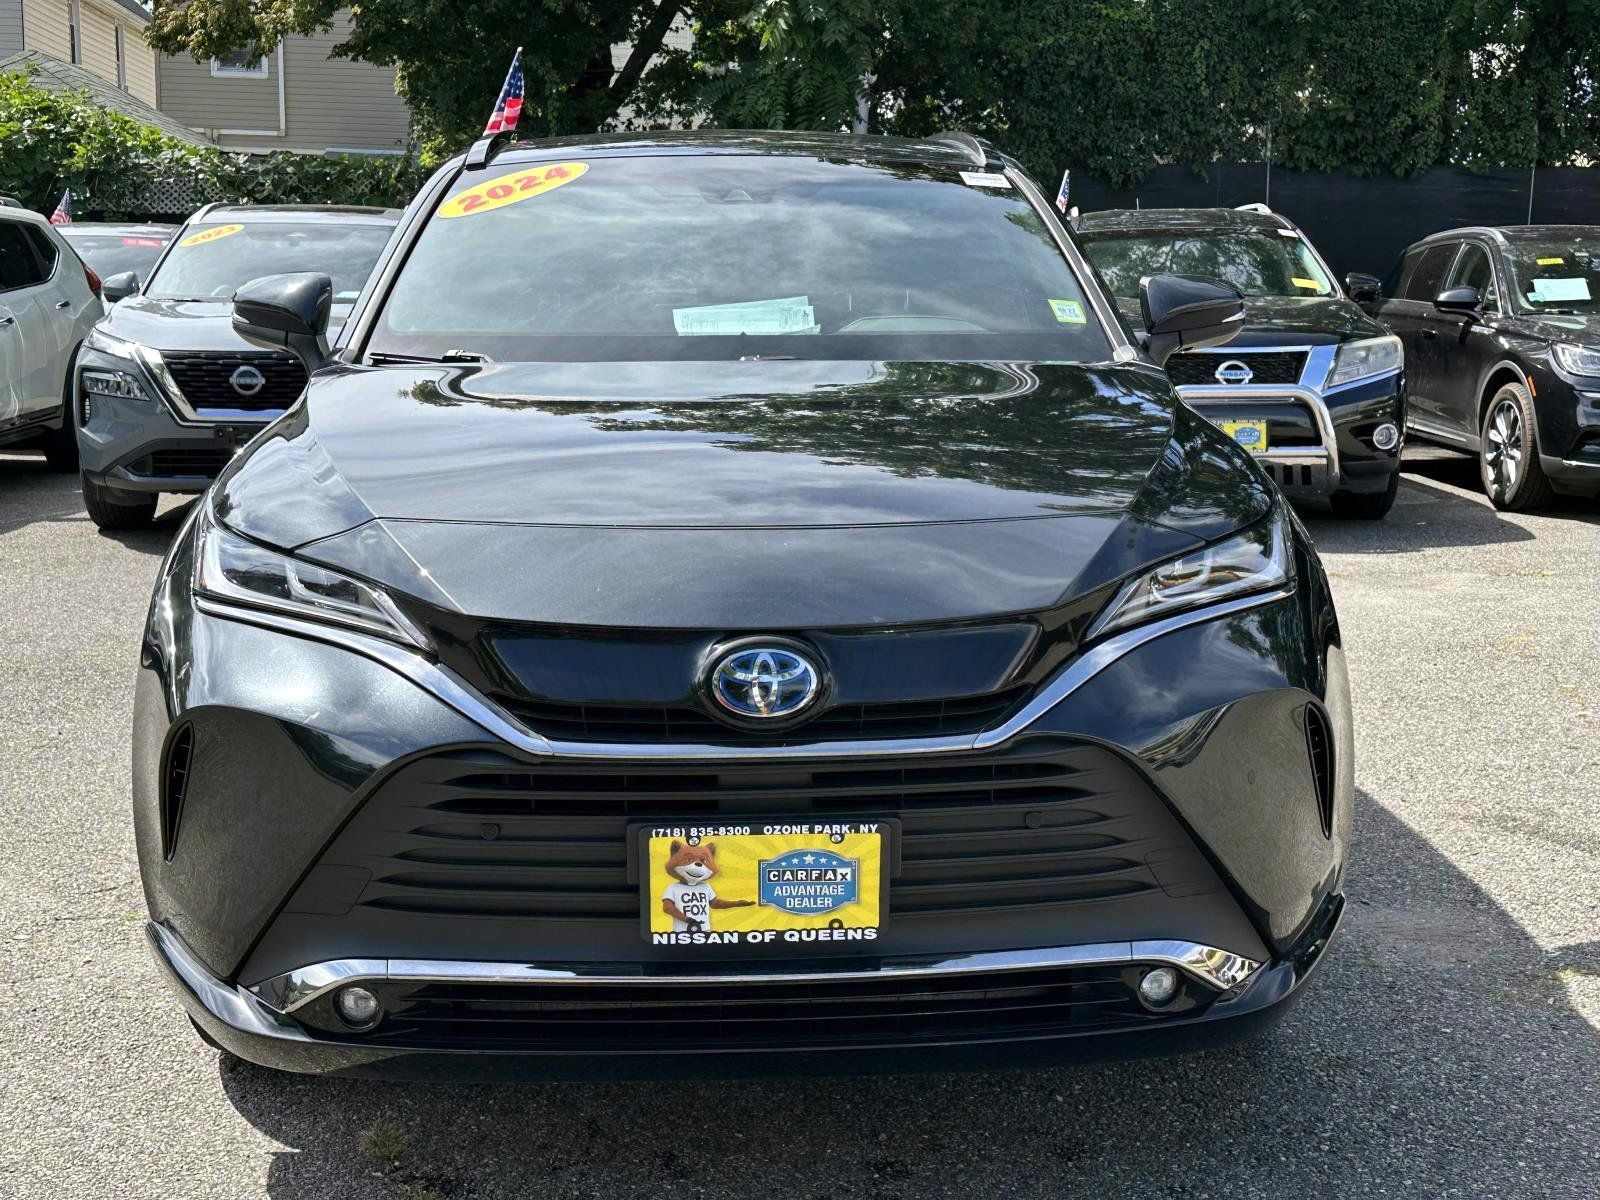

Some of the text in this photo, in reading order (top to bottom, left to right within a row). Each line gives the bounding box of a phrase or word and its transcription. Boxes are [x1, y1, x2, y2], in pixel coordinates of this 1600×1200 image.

[457, 166, 571, 213] 2024
[652, 824, 879, 838] (718) 835-8300 OZONE PARK, NY
[774, 885, 845, 896] ADVANTAGE
[681, 892, 707, 904] CAR
[786, 897, 833, 908] DEALER
[683, 905, 707, 916] FOX
[652, 928, 878, 945] NISSAN OF QUEENS
